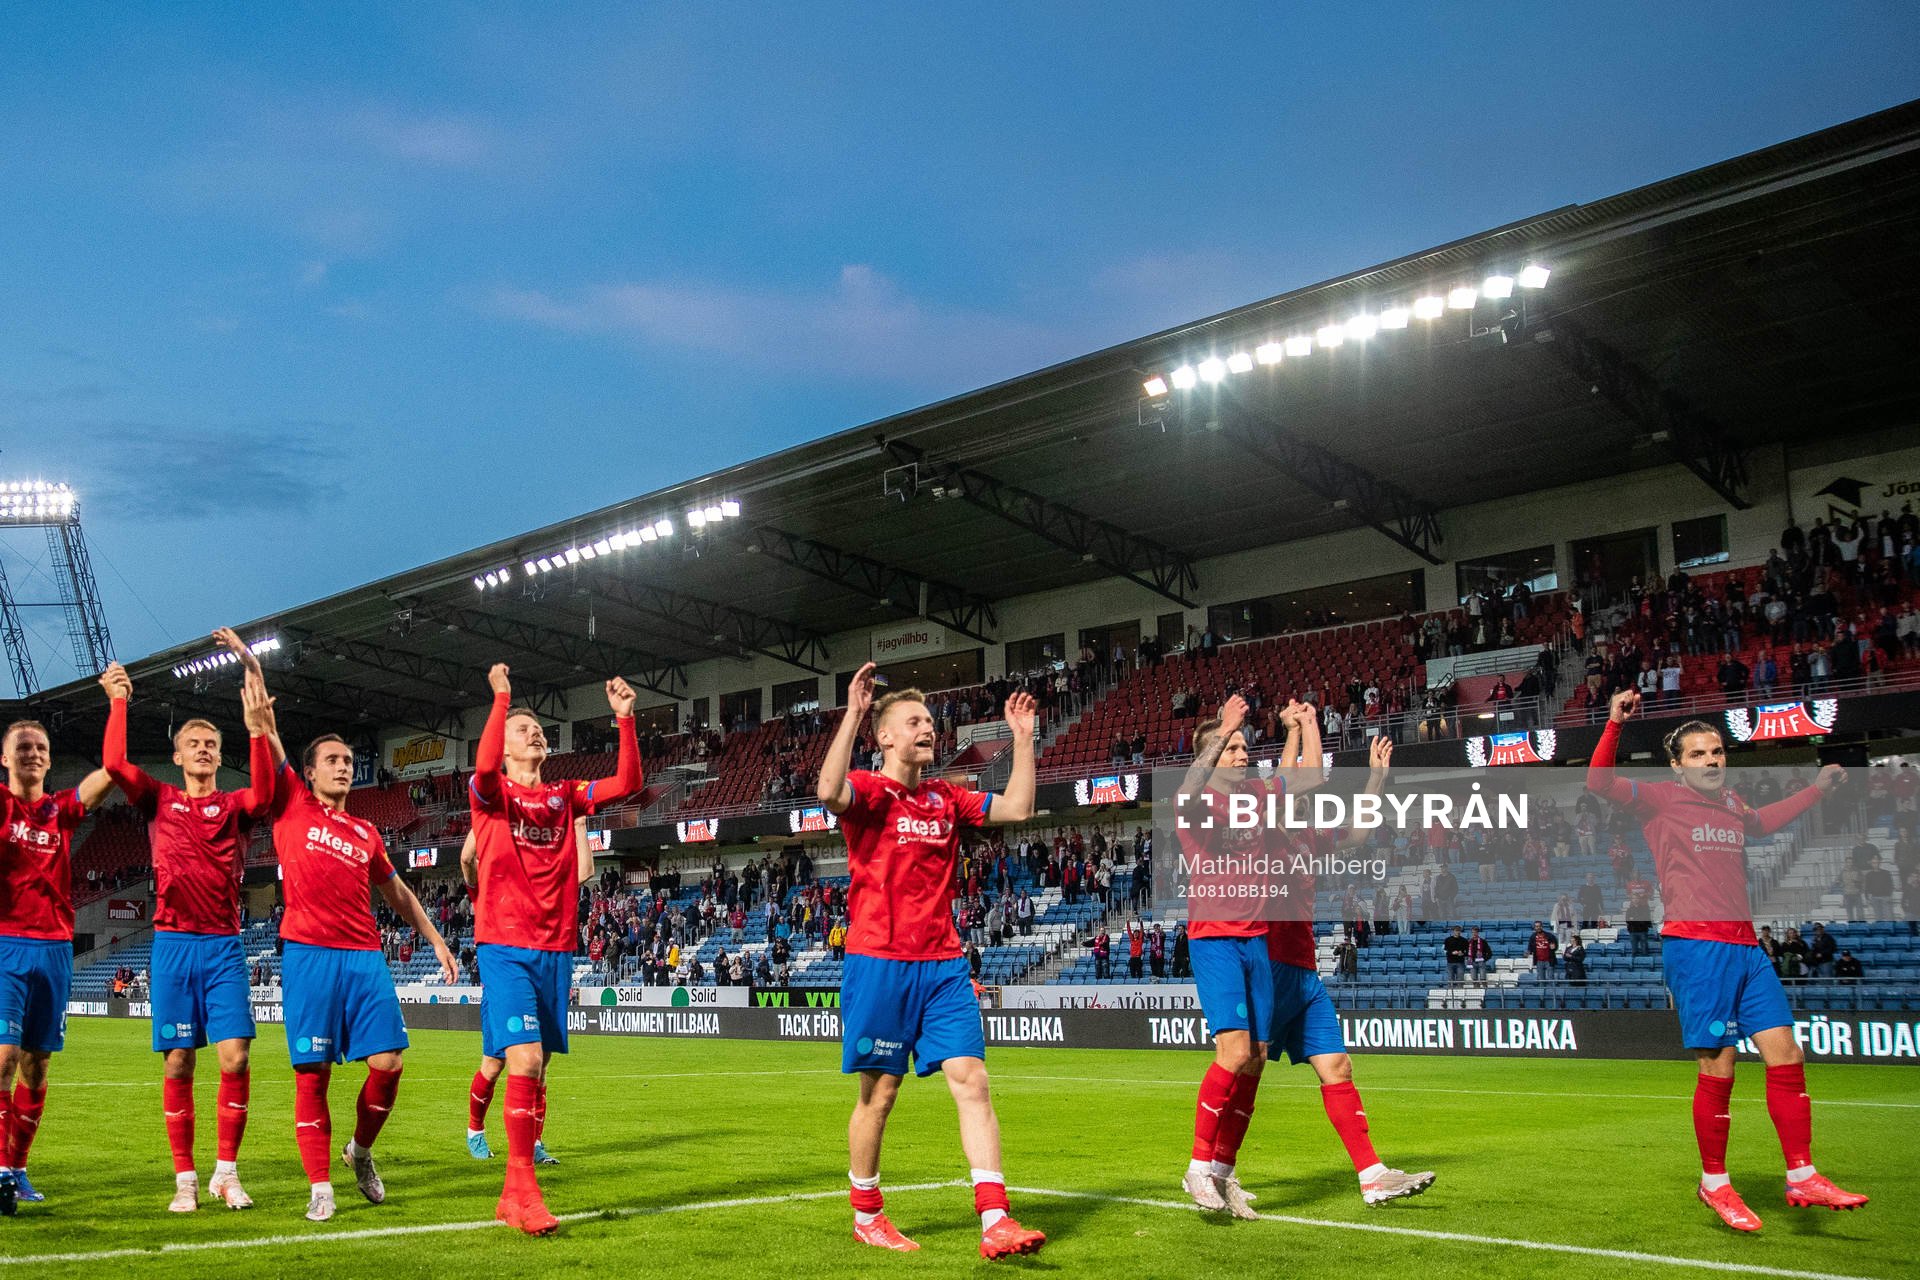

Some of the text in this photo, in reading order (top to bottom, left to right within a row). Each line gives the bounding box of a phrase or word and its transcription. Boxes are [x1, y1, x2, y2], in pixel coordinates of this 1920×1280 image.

[877, 631, 928, 652] #jagvillhbg
[897, 815, 940, 837] akea
[1692, 823, 1736, 844] akea
[307, 826, 353, 857] akea
[109, 909, 136, 919] PUMA
[250, 987, 274, 1000] orp.golf
[618, 988, 642, 1002] Solid
[691, 988, 717, 1003] Solid
[128, 1002, 141, 1016] TACK
[254, 1003, 283, 1021] TACK FÖR
[567, 1011, 586, 1031] DAG
[599, 1009, 664, 1033] VÄLKOMMEN
[667, 1013, 720, 1034] TILLBAKA
[778, 1010, 839, 1037] TACK FÖR
[987, 1016, 1064, 1042] TILLBAKA
[1149, 1017, 1197, 1045] TACK
[874, 1038, 903, 1050] Resurs
[1342, 1017, 1578, 1051] LKOMMEN TILLBAKA
[1792, 1015, 1854, 1056] FÖR
[873, 1047, 893, 1057] Bank
